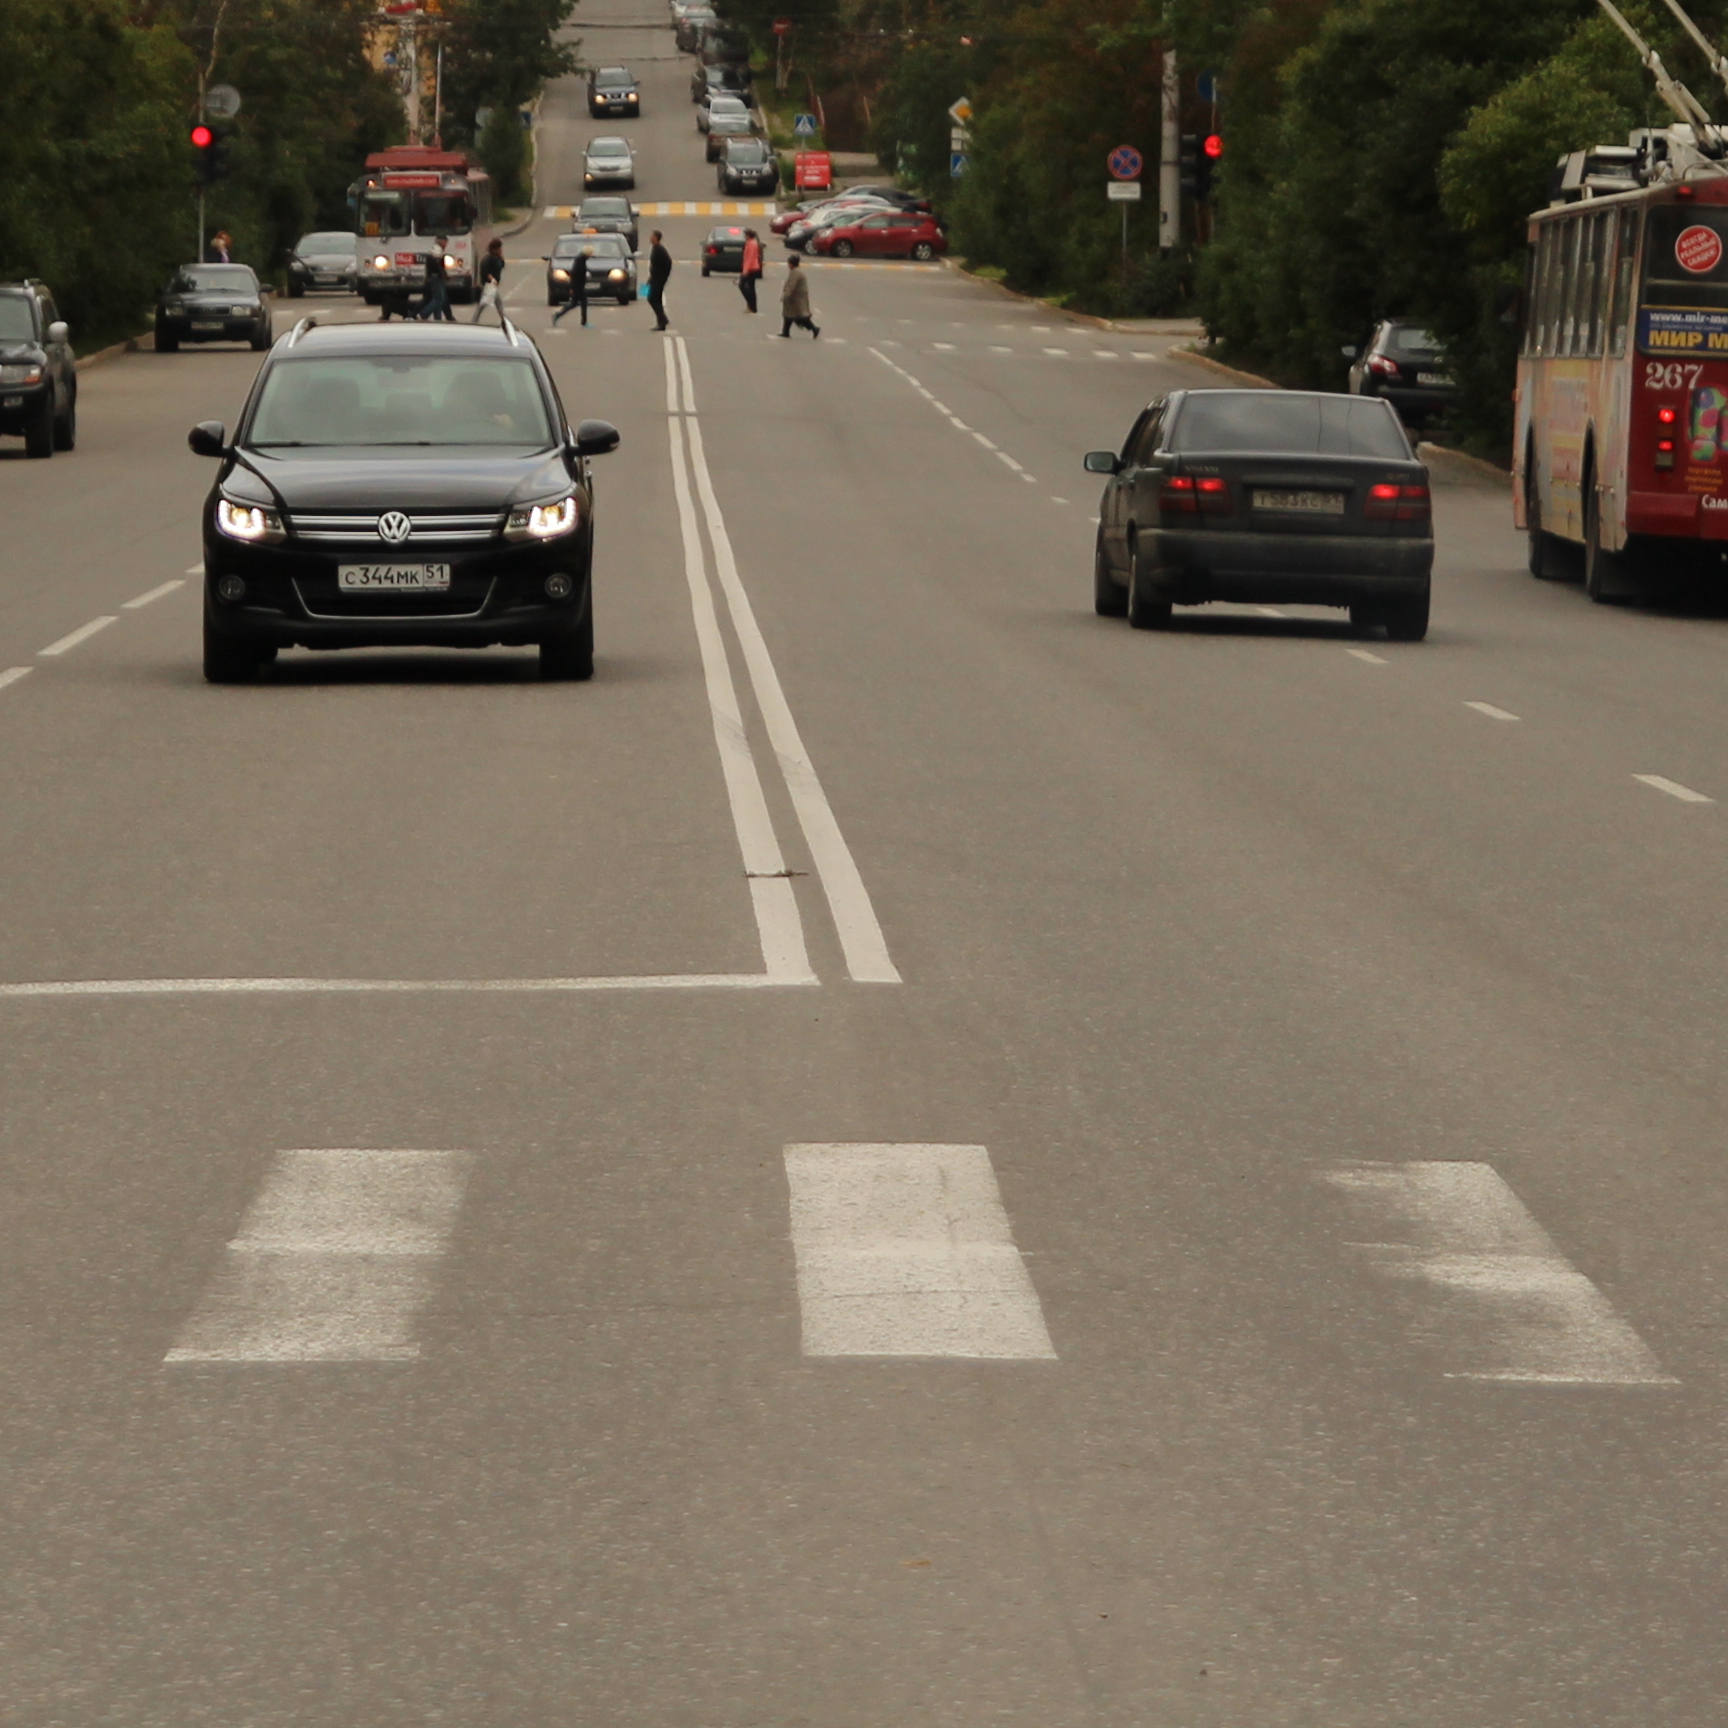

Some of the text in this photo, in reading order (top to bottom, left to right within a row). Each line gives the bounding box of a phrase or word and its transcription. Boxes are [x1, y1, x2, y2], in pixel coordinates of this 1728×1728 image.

[1649, 329, 1704, 347] МИР
[1645, 362, 1704, 390] 267
[345, 563, 445, 586] С344МК 51
